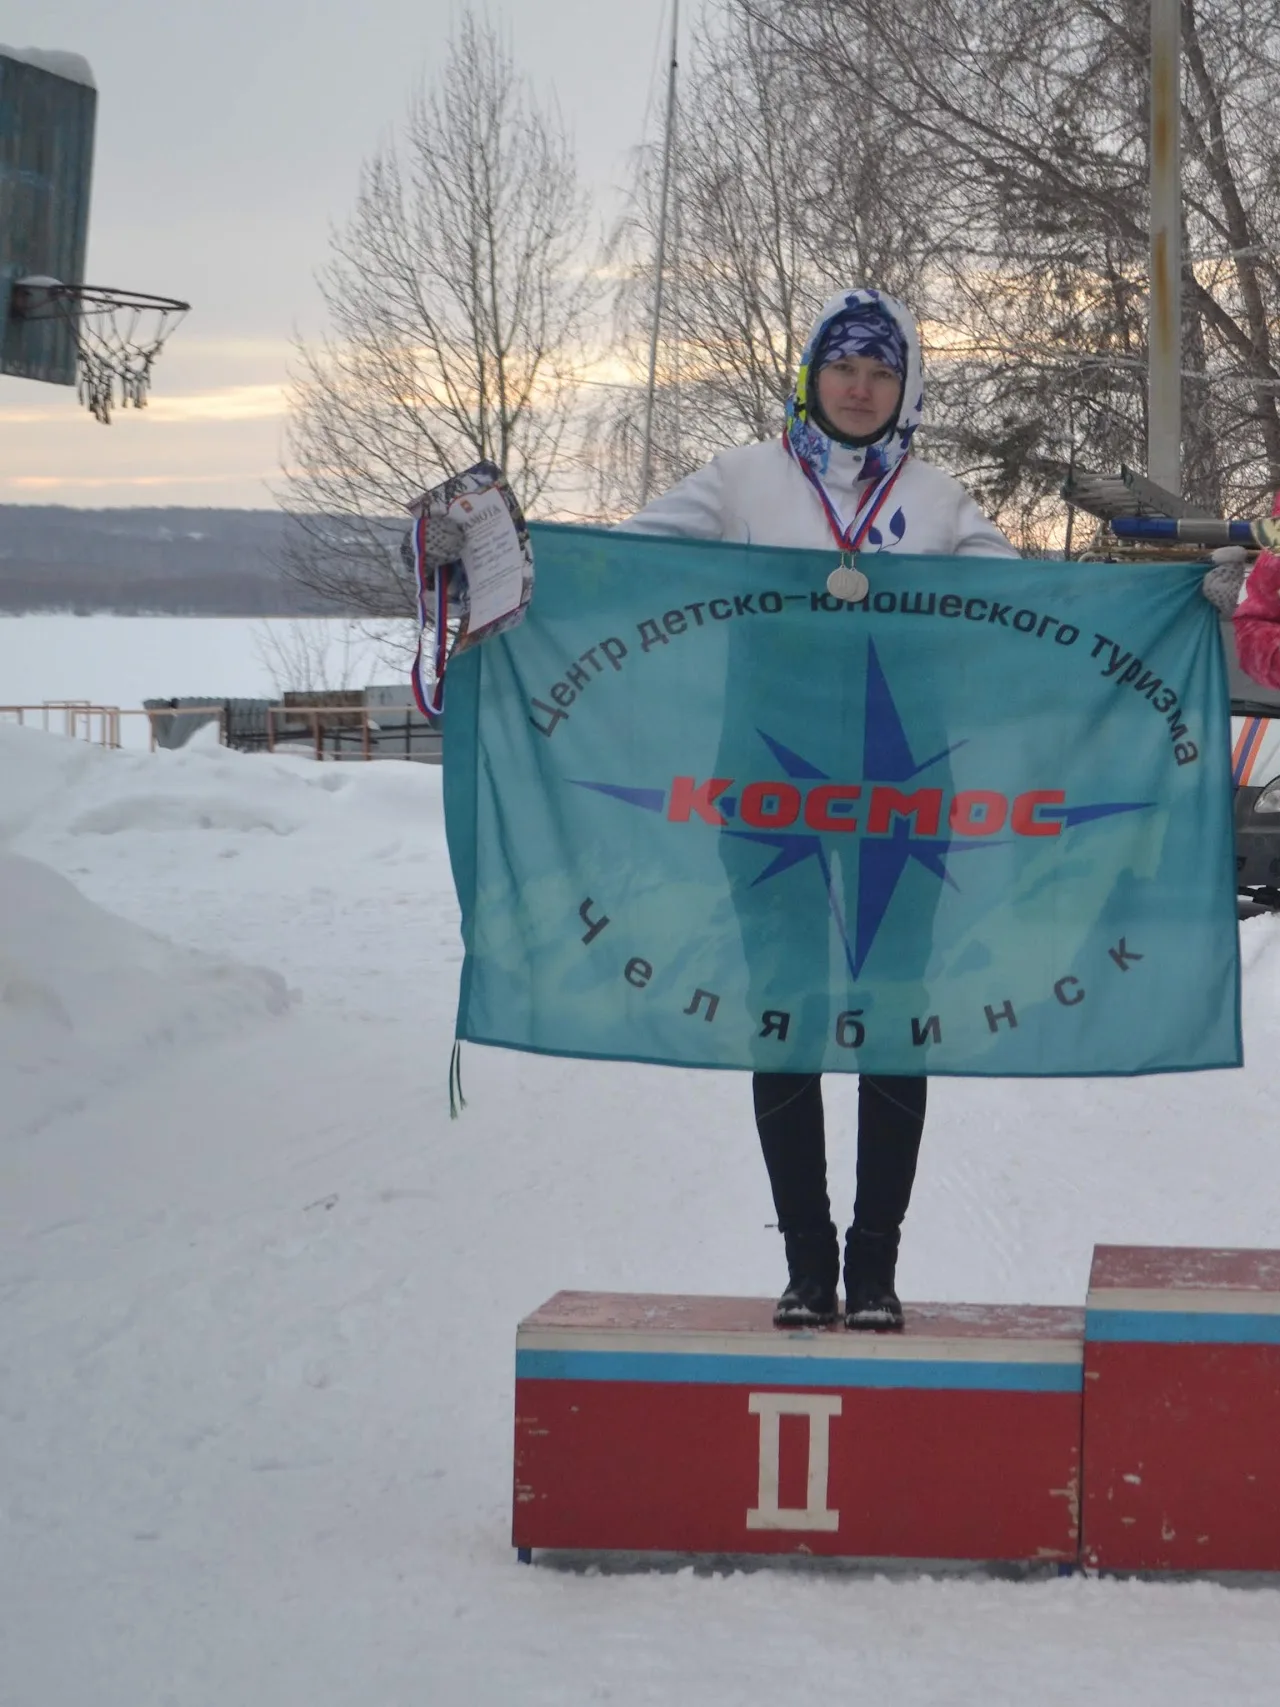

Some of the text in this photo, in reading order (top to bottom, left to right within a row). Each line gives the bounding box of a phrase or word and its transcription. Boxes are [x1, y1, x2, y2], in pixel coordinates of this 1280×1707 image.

[529, 590, 1199, 767] Центр детско-юношеского туризма
[667, 775, 1066, 837] КОСМОС
[578, 897, 1144, 1049] Челябинск
